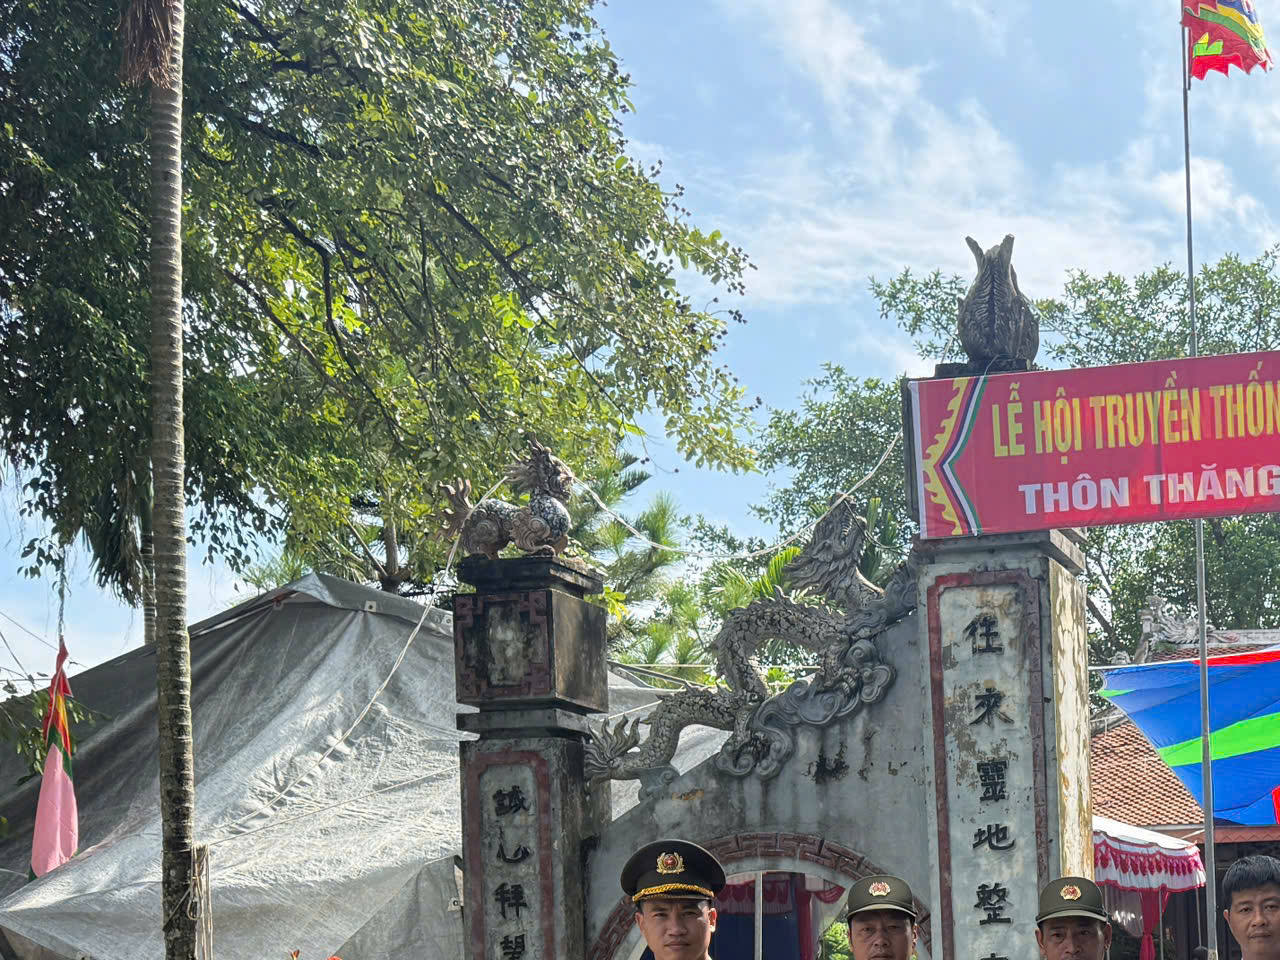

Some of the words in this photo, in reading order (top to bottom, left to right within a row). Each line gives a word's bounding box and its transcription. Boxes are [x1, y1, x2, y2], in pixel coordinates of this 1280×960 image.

[992, 382, 1025, 457] LỄ
[1033, 387, 1083, 464] HỘI
[1089, 371, 1202, 449] TRUYỀN
[1018, 473, 1130, 515] THÔN
